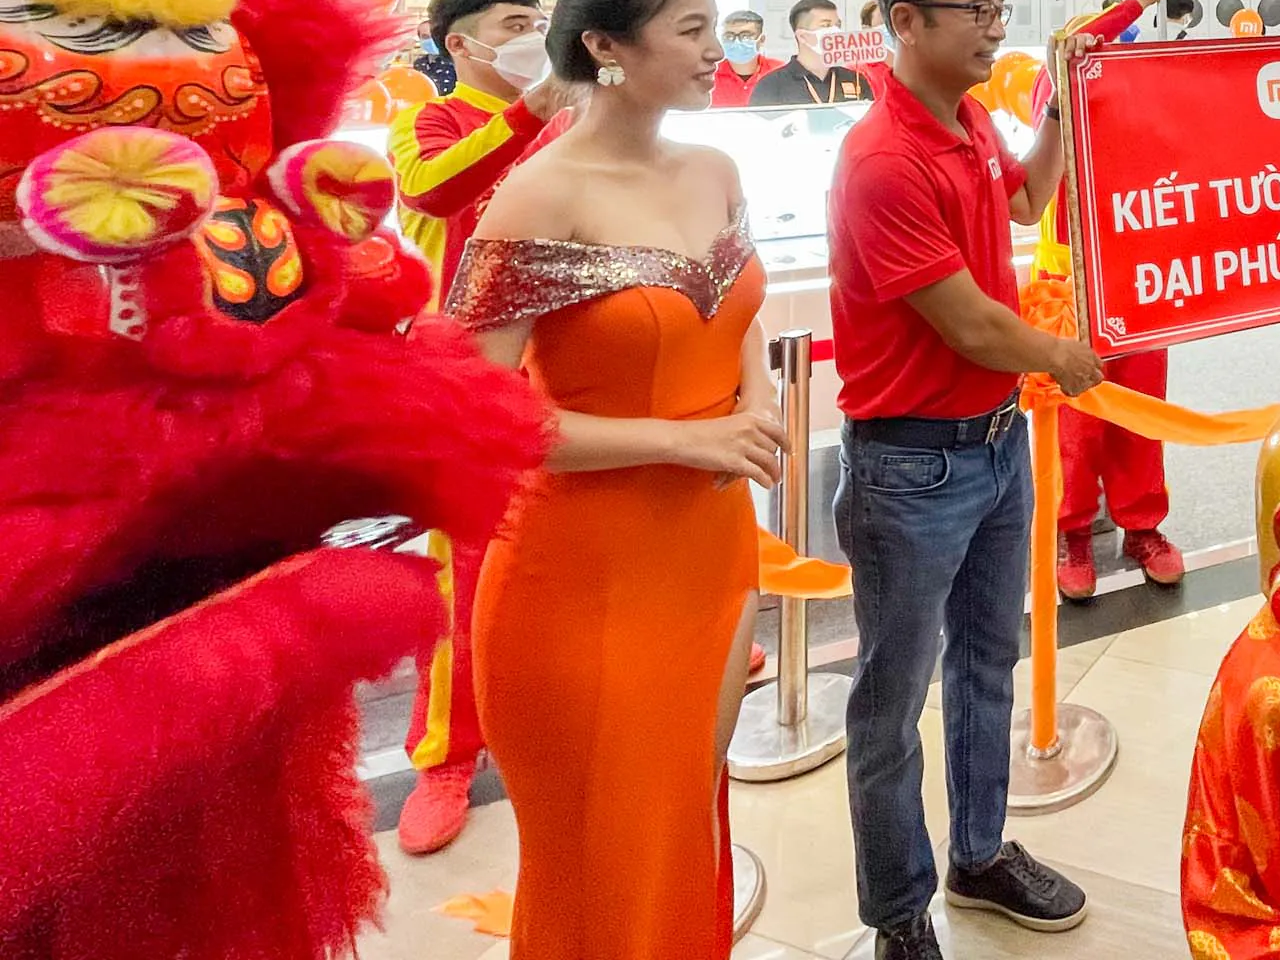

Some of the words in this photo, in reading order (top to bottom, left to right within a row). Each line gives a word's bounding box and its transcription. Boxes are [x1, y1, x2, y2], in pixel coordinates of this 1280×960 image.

[821, 31, 883, 51] GRAND
[823, 45, 885, 65] OPENING
[1111, 171, 1200, 233] KIẾT
[1134, 255, 1204, 308] ĐẠI
